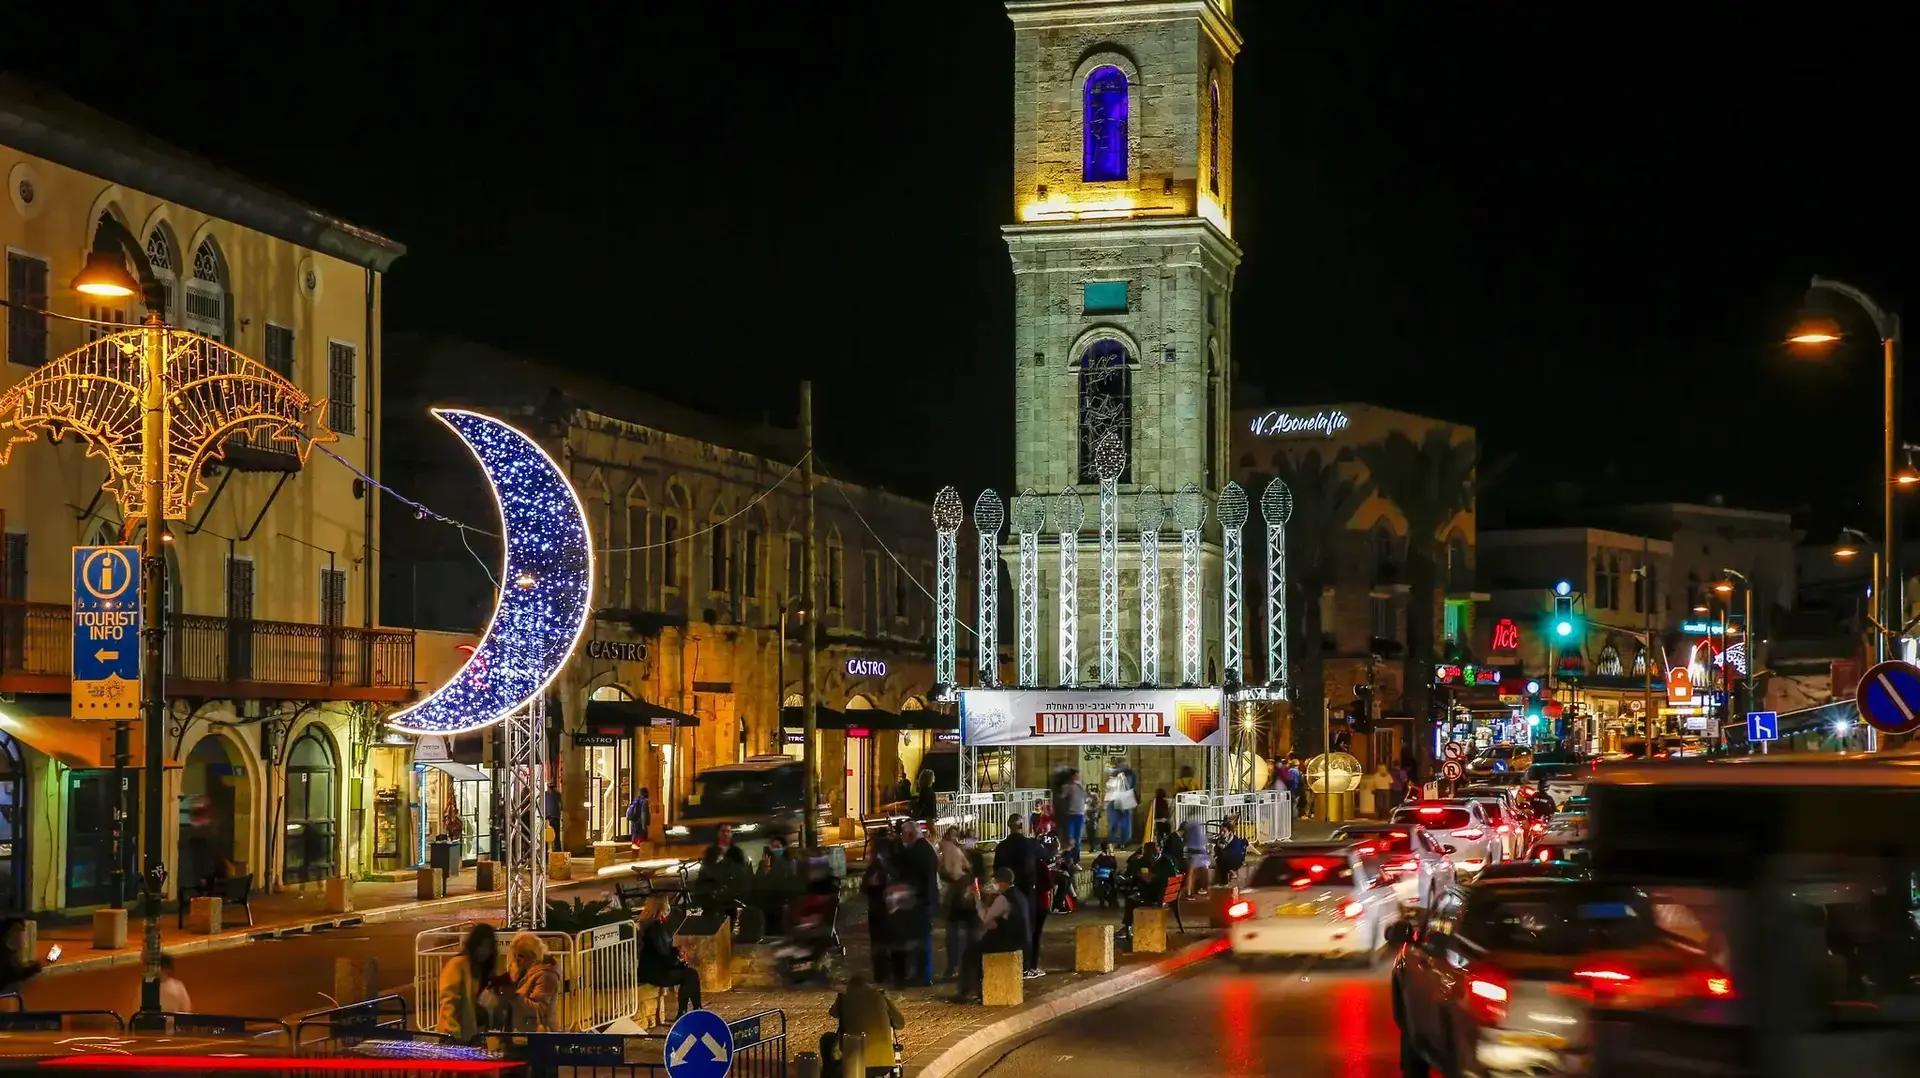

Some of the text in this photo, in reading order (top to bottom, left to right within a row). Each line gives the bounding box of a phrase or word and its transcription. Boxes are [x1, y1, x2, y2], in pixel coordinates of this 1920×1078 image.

[76, 611, 138, 626] TOURIST
[90, 625, 123, 640] INFO
[590, 640, 648, 661] CASTRO
[847, 659, 886, 676] CASTRO
[1045, 702, 1074, 710] מאחלת
[1129, 702, 1155, 710] עיריית
[1043, 714, 1159, 732] חג אורים שמח
